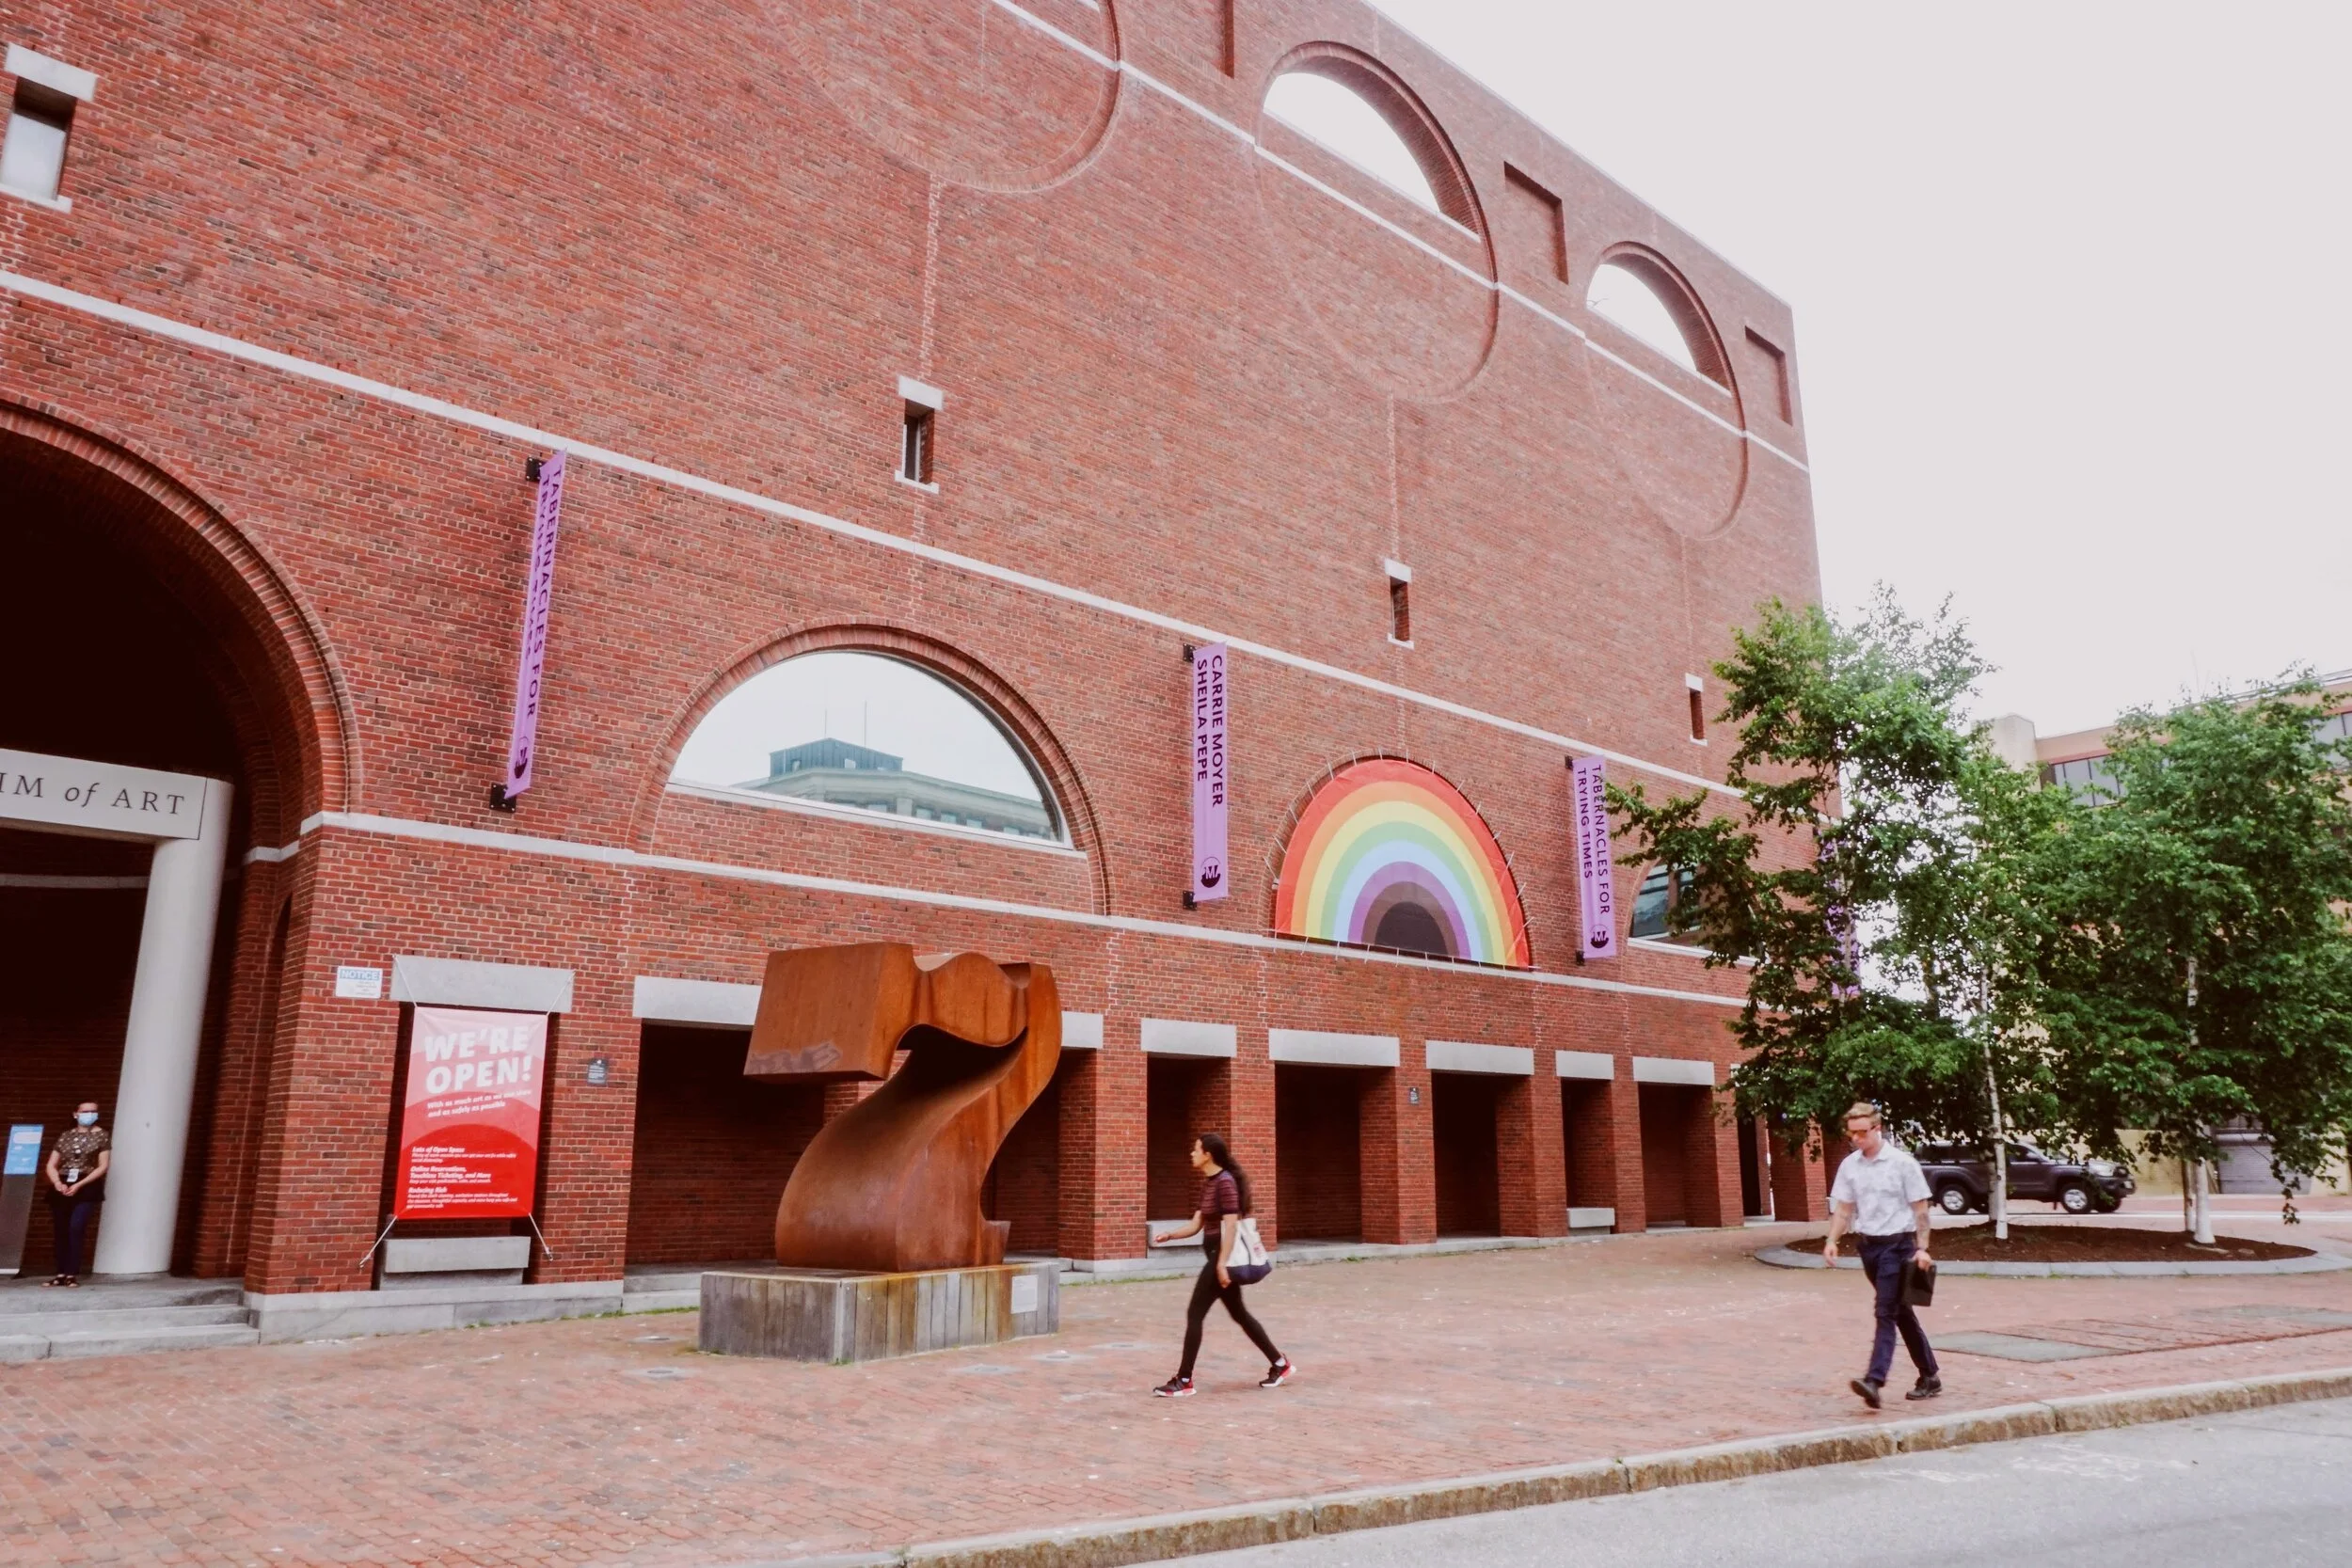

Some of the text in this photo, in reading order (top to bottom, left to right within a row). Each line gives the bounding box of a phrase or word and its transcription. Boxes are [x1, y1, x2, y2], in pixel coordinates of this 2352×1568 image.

[527, 464, 562, 720] TABERNACLES FOR
[1197, 658, 1208, 782] SHEILA PEPE
[1212, 655, 1223, 808] CARRIE MOYER
[64, 783, 100, 807] of
[111, 788, 184, 815] ART
[1578, 768, 1593, 879] TRYING TIMES
[1592, 765, 1611, 914] TABERNACLES FOR
[342, 970, 377, 979] NOTICE
[424, 1025, 530, 1062] WE'RE
[426, 1055, 532, 1094] OPEN!
